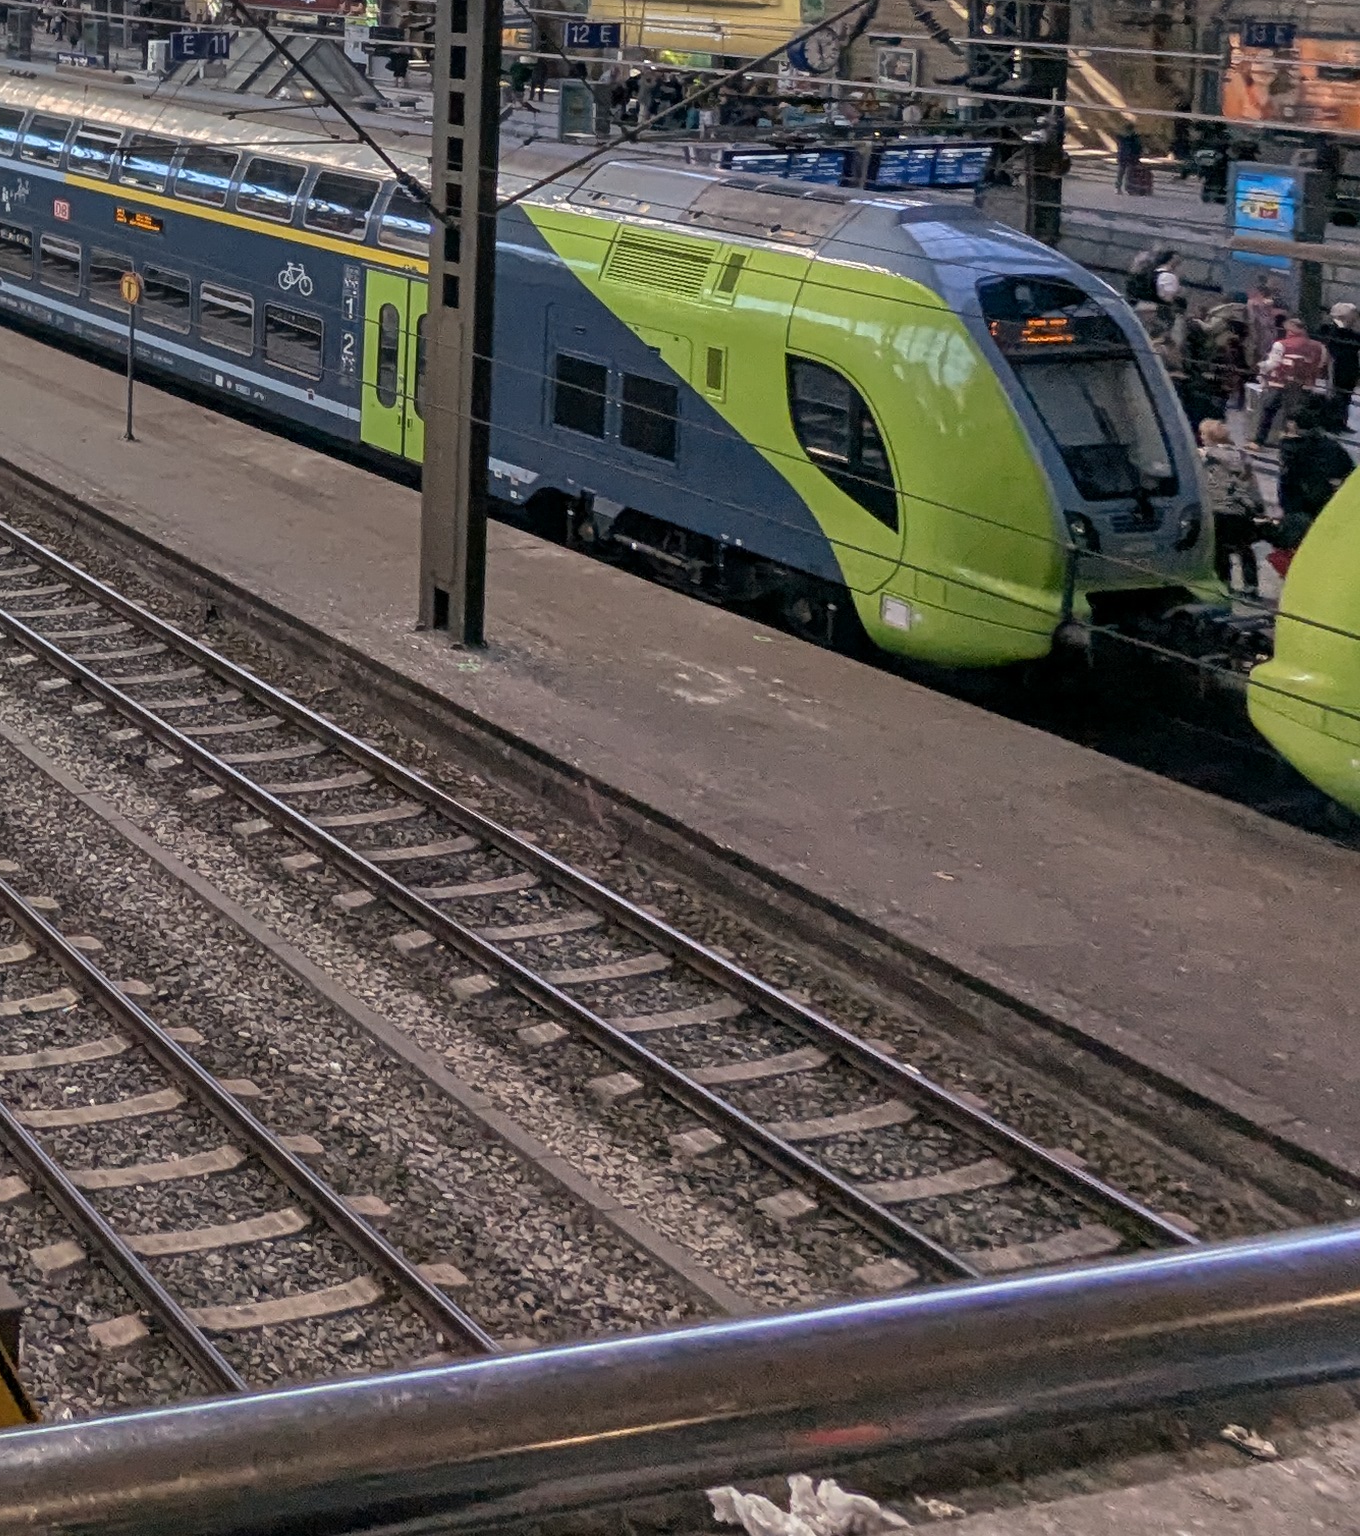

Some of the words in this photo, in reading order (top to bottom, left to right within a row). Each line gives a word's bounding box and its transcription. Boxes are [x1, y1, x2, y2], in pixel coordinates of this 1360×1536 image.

[571, 26, 589, 43] 12
[600, 26, 611, 43] E
[183, 35, 195, 54] E
[211, 35, 227, 53] 11
[54, 201, 68, 218] DB
[346, 298, 353, 315] 1
[343, 333, 354, 355] 2
